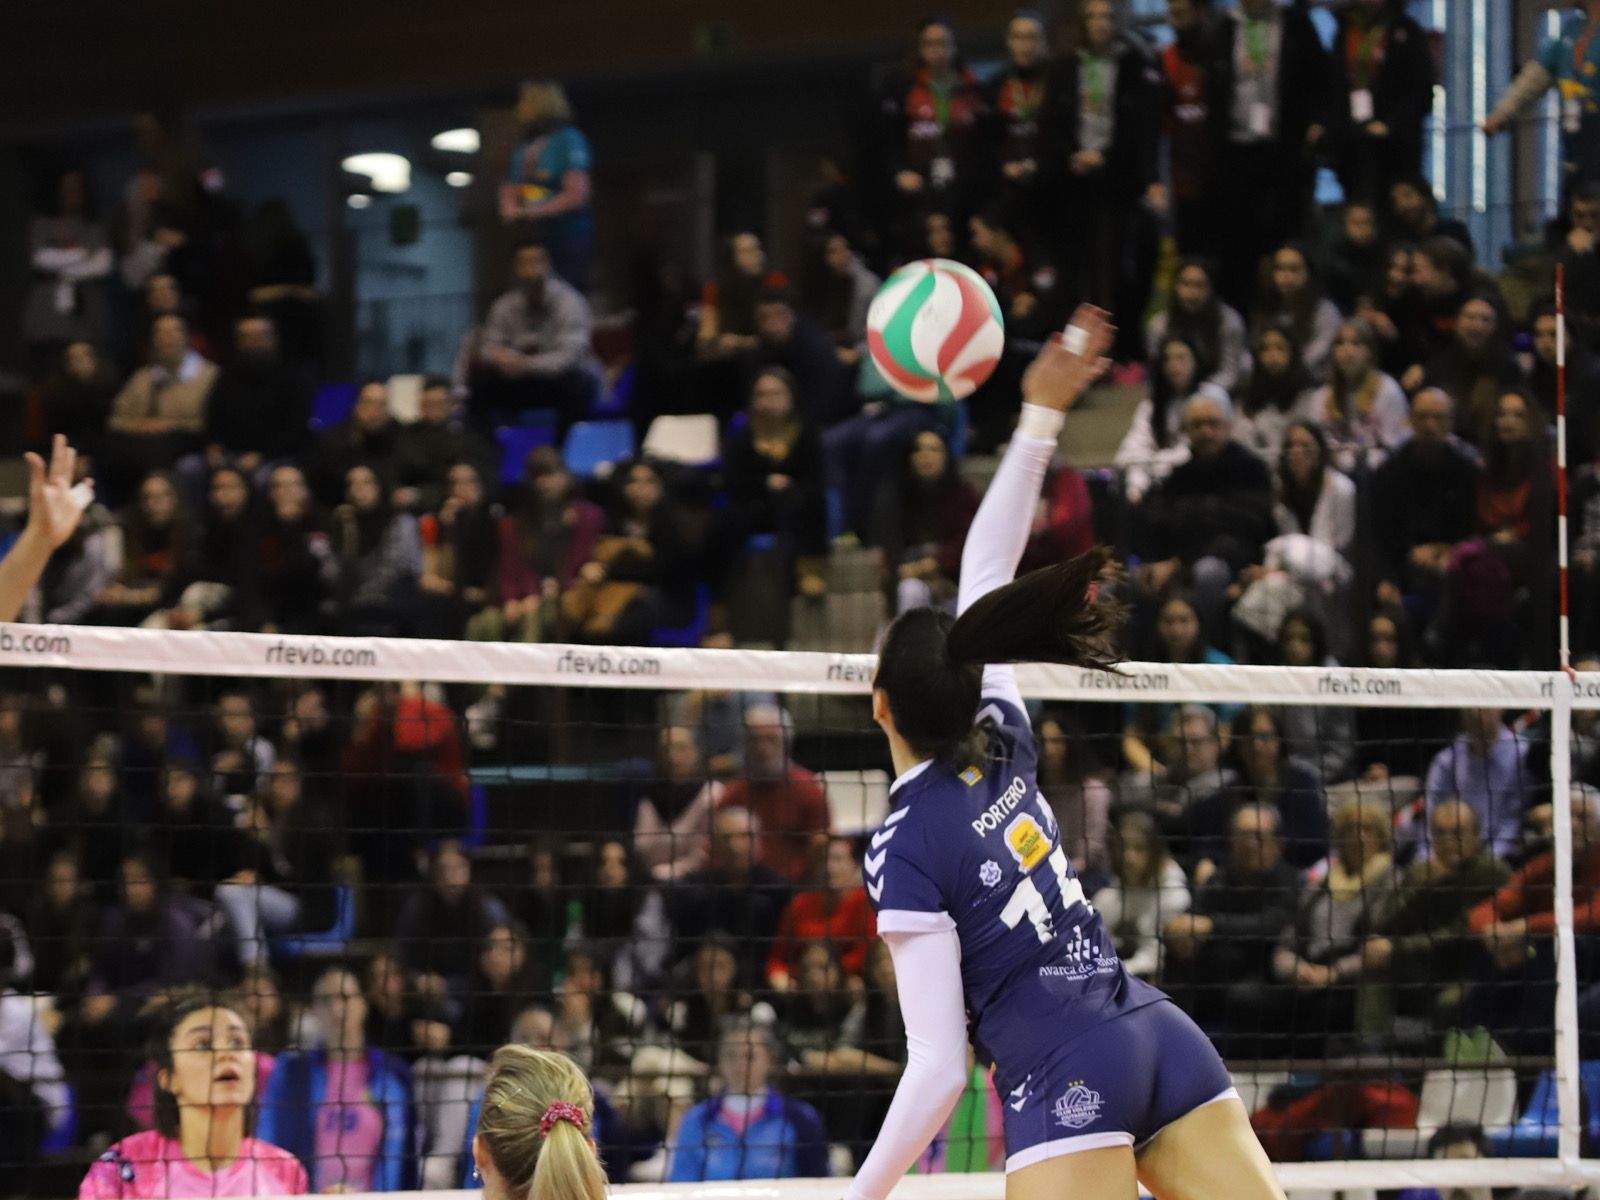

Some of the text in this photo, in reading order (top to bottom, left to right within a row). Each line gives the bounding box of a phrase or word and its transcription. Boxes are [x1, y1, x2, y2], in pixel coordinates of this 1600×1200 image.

[0, 625, 71, 653] b.com
[265, 640, 377, 666] rfevb.com
[557, 650, 660, 675] rfevb.com
[1318, 672, 1402, 694] rfevb.com
[971, 776, 1027, 838] PORTERO
[1039, 964, 1077, 977] Avarca
